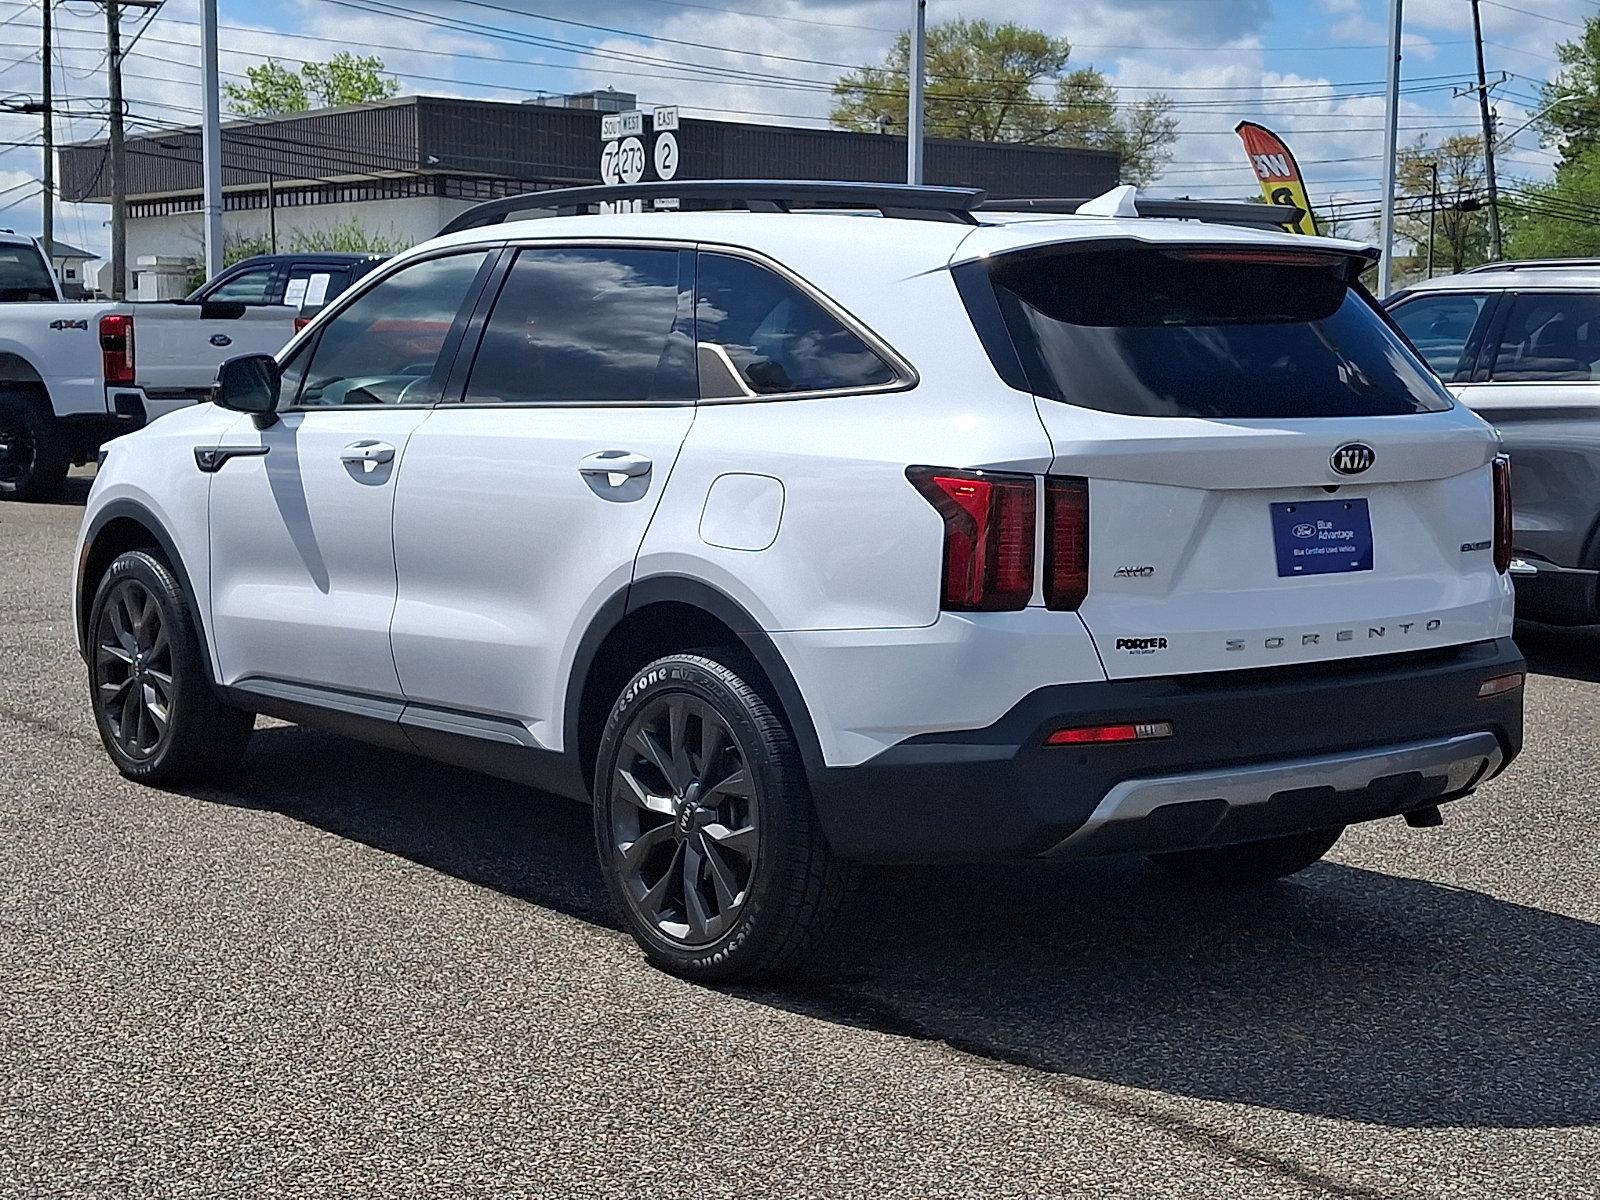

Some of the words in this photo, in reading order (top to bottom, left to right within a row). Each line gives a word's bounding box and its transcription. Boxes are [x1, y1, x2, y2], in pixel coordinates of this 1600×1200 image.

[623, 116, 640, 131] WEST
[657, 111, 674, 127] EAST
[604, 120, 620, 135] SOUT
[604, 151, 620, 177] 72
[621, 147, 643, 174] 273
[662, 143, 671, 170] 2
[1339, 449, 1370, 469] KIA
[1316, 520, 1333, 530] Blue
[1318, 530, 1354, 541] Advantage
[1113, 565, 1155, 578] AWD
[1225, 618, 1442, 652] SORENTO
[1116, 637, 1168, 650] PORTER
[680, 806, 691, 828] KIA
